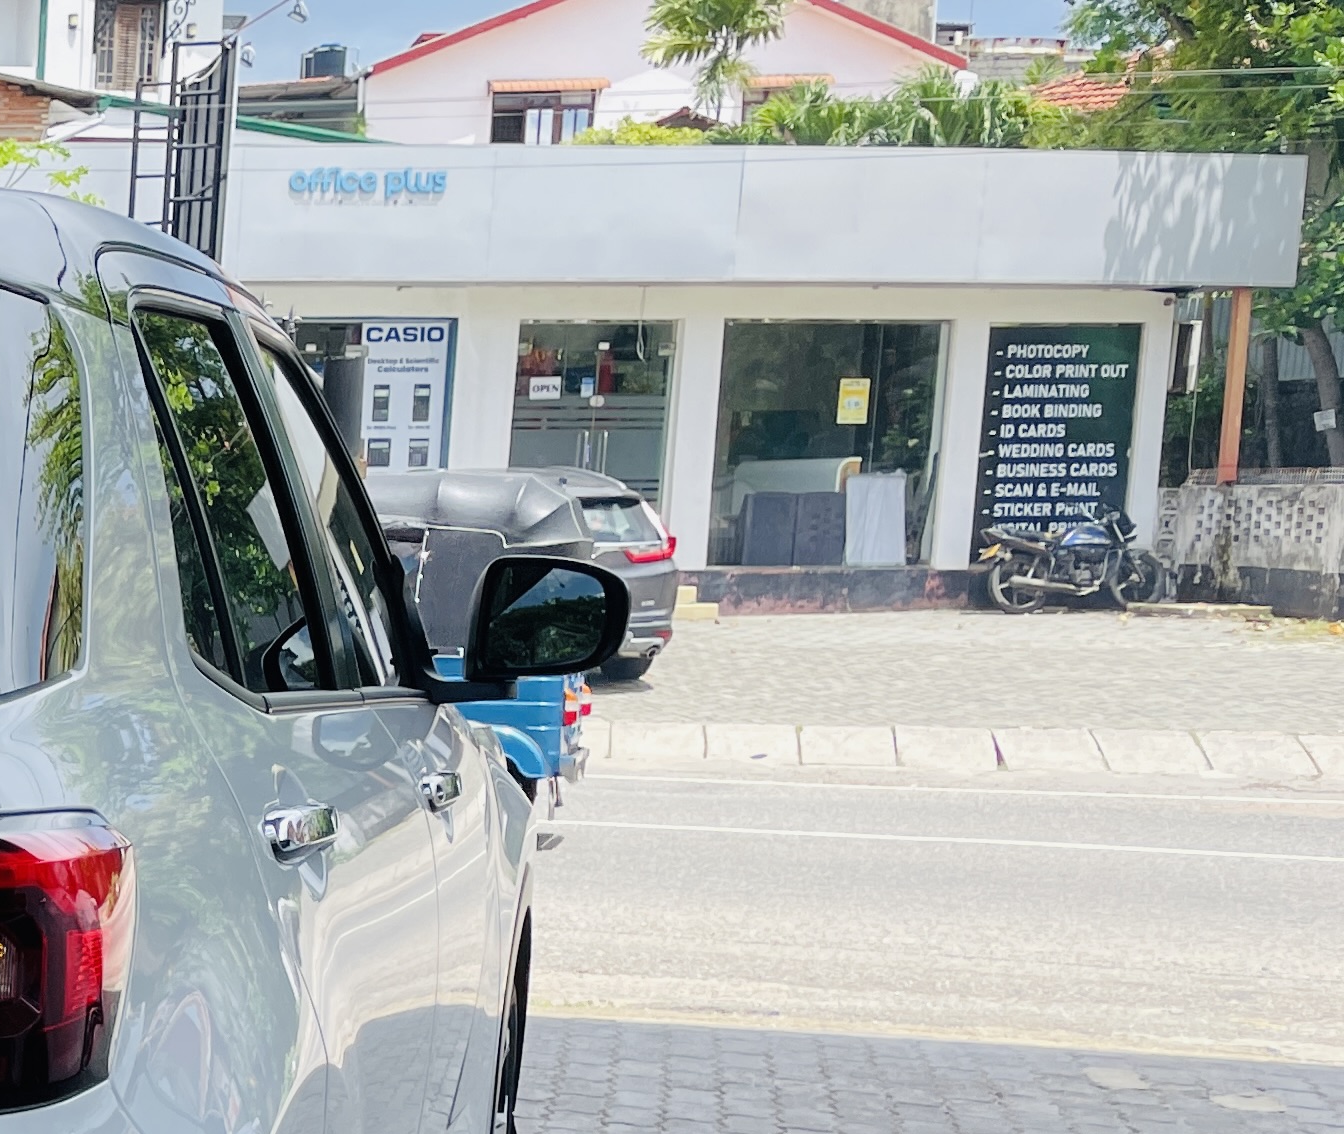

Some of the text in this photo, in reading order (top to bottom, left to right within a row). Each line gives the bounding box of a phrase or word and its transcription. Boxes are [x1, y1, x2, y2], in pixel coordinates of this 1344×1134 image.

[289, 166, 447, 199] office plus
[366, 326, 444, 342] CASIO
[1007, 344, 1089, 358] PHOTOCOPY
[1005, 364, 1129, 378] COLOR PRINT OUT
[532, 384, 559, 393] OPEN
[1004, 384, 1090, 398] LAMINATING
[1002, 404, 1102, 418] BOOK BINDING
[1000, 424, 1066, 438] ID CARDS
[998, 443, 1115, 458] WEDDING CARDS
[996, 463, 1117, 477] BUSINESS CARDS
[995, 482, 1100, 497] SCAN & E-MAIL
[993, 502, 1098, 517] STICKER PRINT
